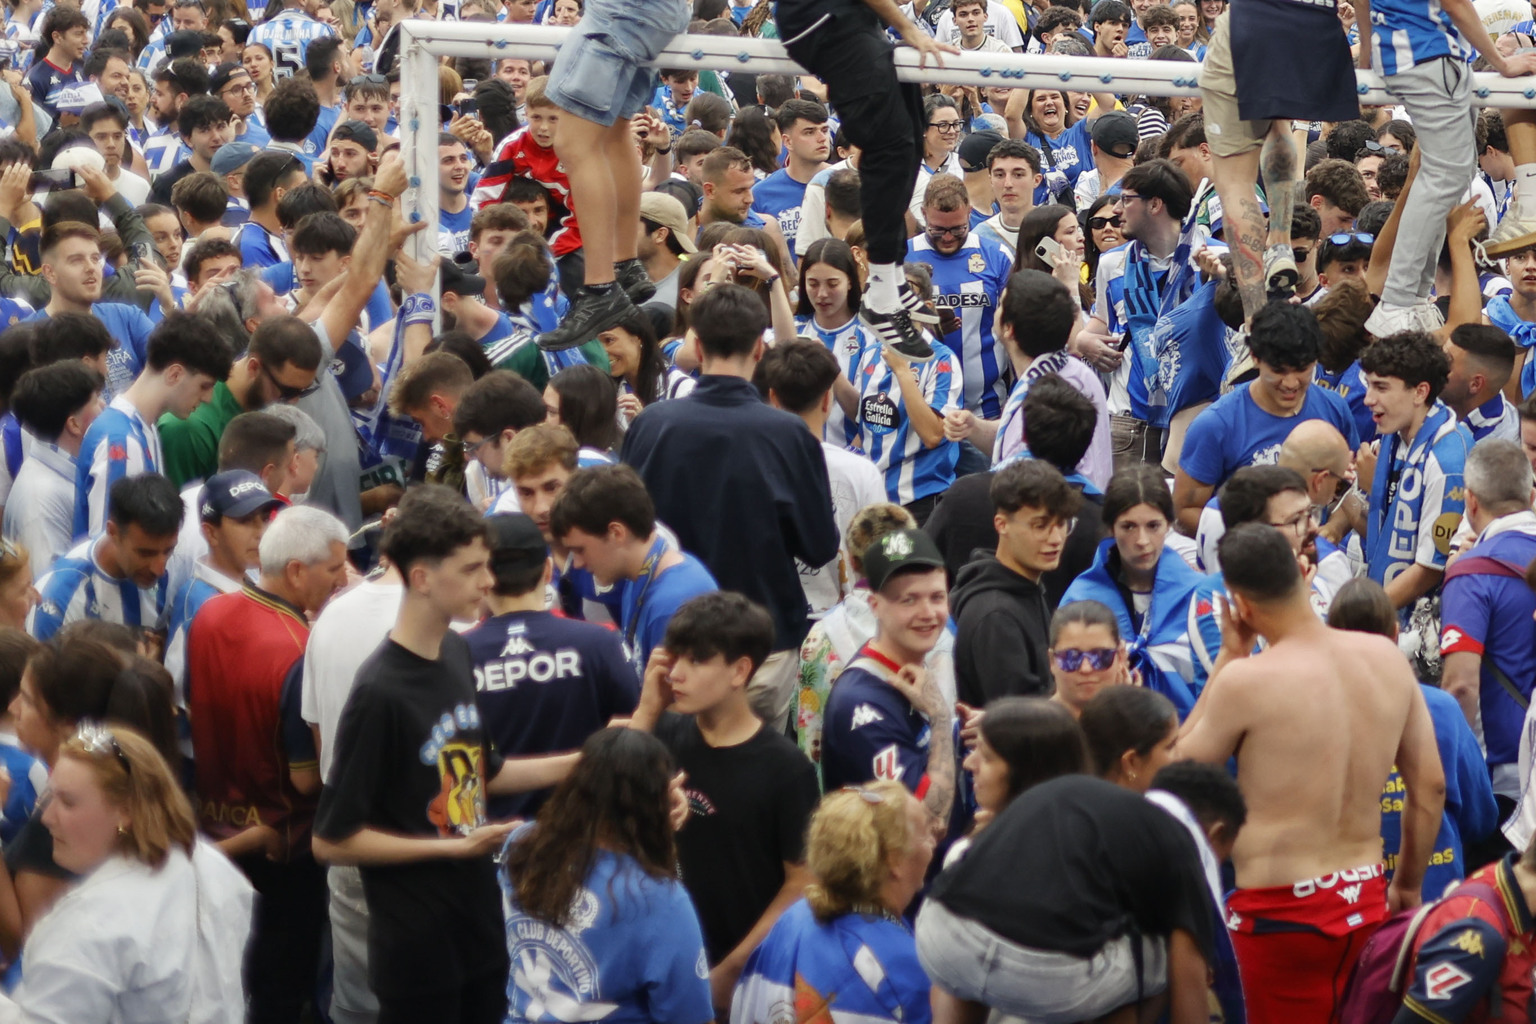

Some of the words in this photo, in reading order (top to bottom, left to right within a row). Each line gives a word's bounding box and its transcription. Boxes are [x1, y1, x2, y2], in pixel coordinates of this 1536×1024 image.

[864, 400, 893, 415] Estrella
[865, 410, 892, 426] Galicia
[516, 922, 545, 942] CLUB
[545, 925, 592, 995] DEPORTIVO
